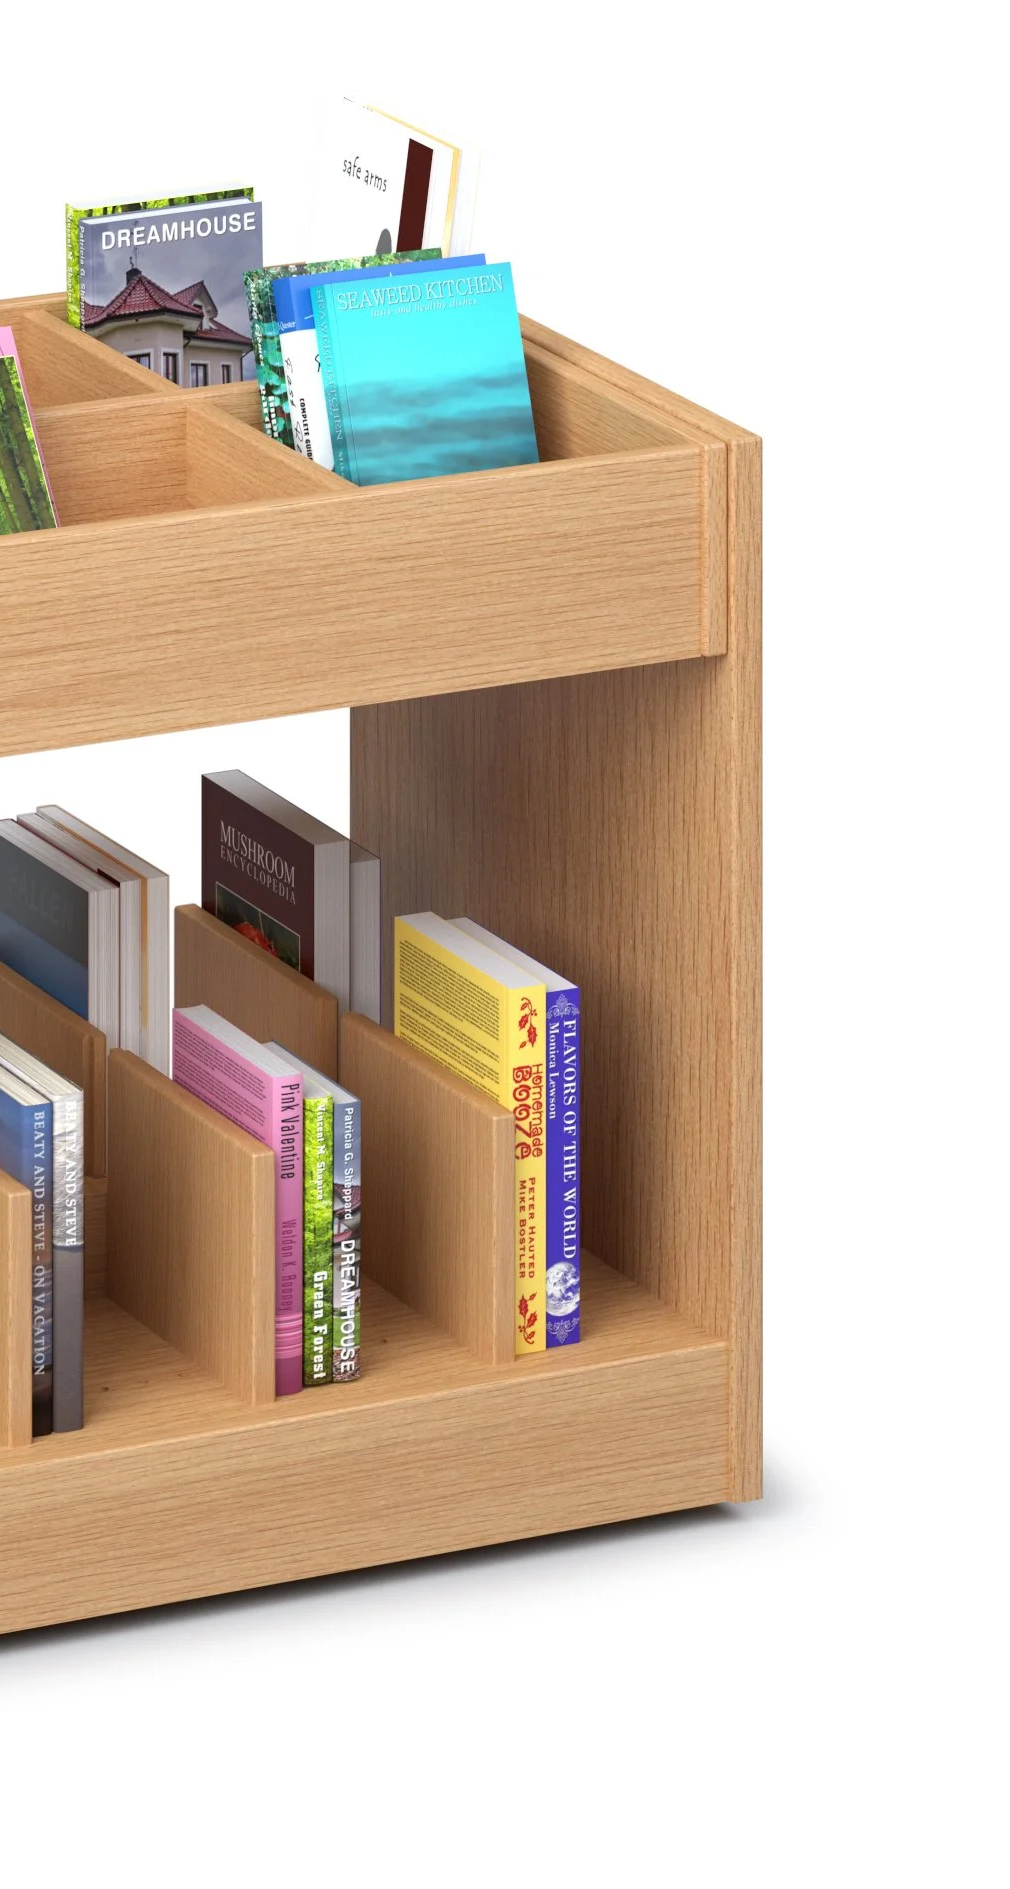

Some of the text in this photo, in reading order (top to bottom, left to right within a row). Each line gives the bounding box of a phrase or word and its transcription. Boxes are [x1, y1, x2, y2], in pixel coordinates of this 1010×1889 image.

[342, 155, 387, 192] safe arms
[101, 211, 257, 251] DREAMHOUSE
[337, 273, 505, 311] SEAWEED KITCHEN
[299, 398, 310, 436] COMPLETE
[326, 371, 342, 441] KITCHEN
[220, 819, 295, 888] MUSHROOM
[220, 844, 296, 905] ENCYCLOPEDIA
[549, 1022, 560, 1119] Monica Lewson
[280, 1083, 300, 1113] Pink
[531, 1063, 543, 1158] Homemade
[33, 1111, 45, 1159] BEATY
[317, 1104, 326, 1141] Vincent
[563, 1019, 577, 1259] FLAVORS OF THE WORLD
[280, 1115, 300, 1180] Valentine
[33, 1165, 45, 1199] AND
[65, 1159, 77, 1194] AND
[315, 1161, 326, 1200] Shapiro
[33, 1203, 45, 1251] STEVE
[65, 1199, 77, 1246] STEVE
[281, 1219, 297, 1258] Weldon
[340, 1107, 355, 1373] Patricia G. Sheppard DREAMHOUSE
[519, 1180, 527, 1279] MIKE BOSTLER
[528, 1177, 536, 1279] PETER HAUTED
[34, 1265, 45, 1288] ON
[279, 1274, 297, 1311] Rooney
[313, 1270, 328, 1320] Green
[34, 1293, 45, 1376] VACATION
[313, 1324, 328, 1379] Forest
